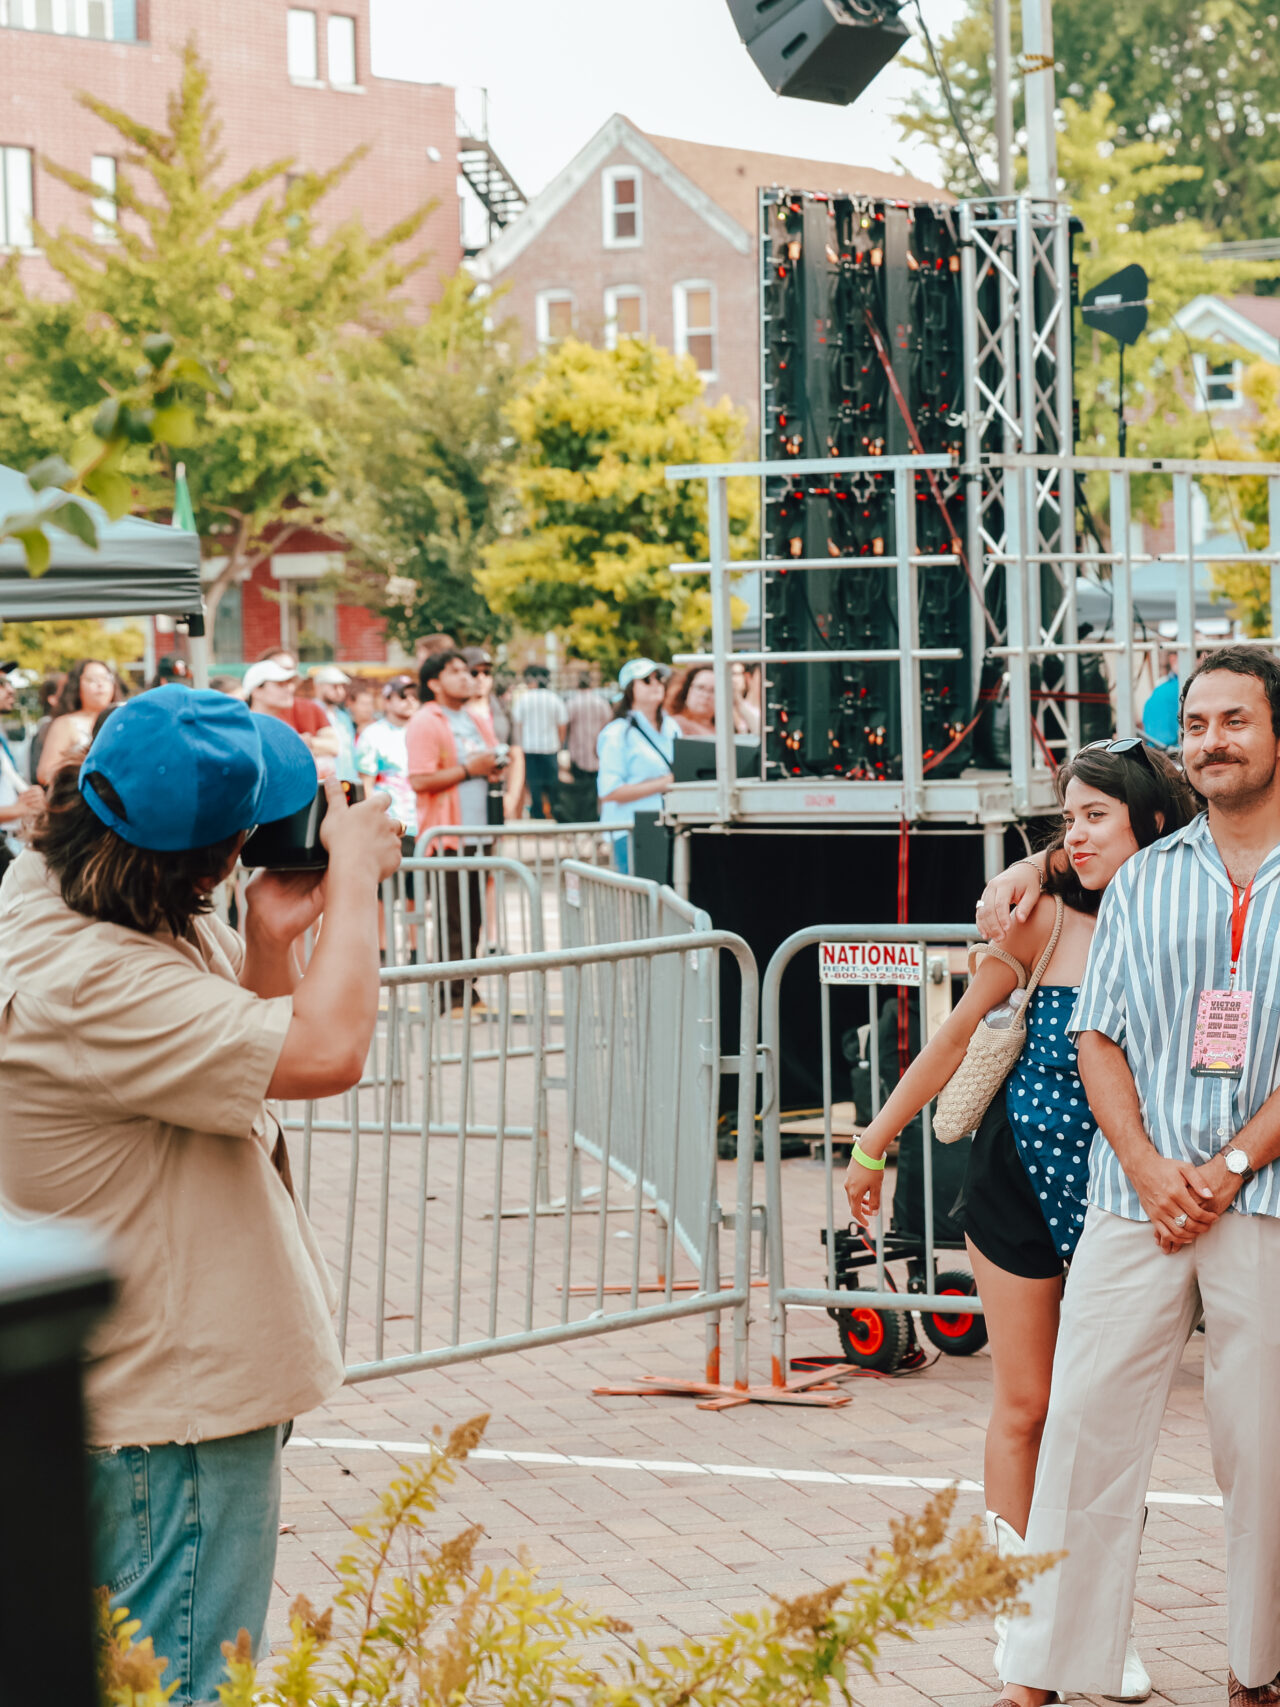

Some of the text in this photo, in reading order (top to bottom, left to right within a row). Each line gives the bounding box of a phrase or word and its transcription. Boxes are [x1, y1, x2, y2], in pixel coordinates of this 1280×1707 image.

[823, 945, 919, 966] NATIONAL
[823, 966, 920, 974] RENT-A-FENCE
[823, 973, 920, 981] 1-800-352-5675
